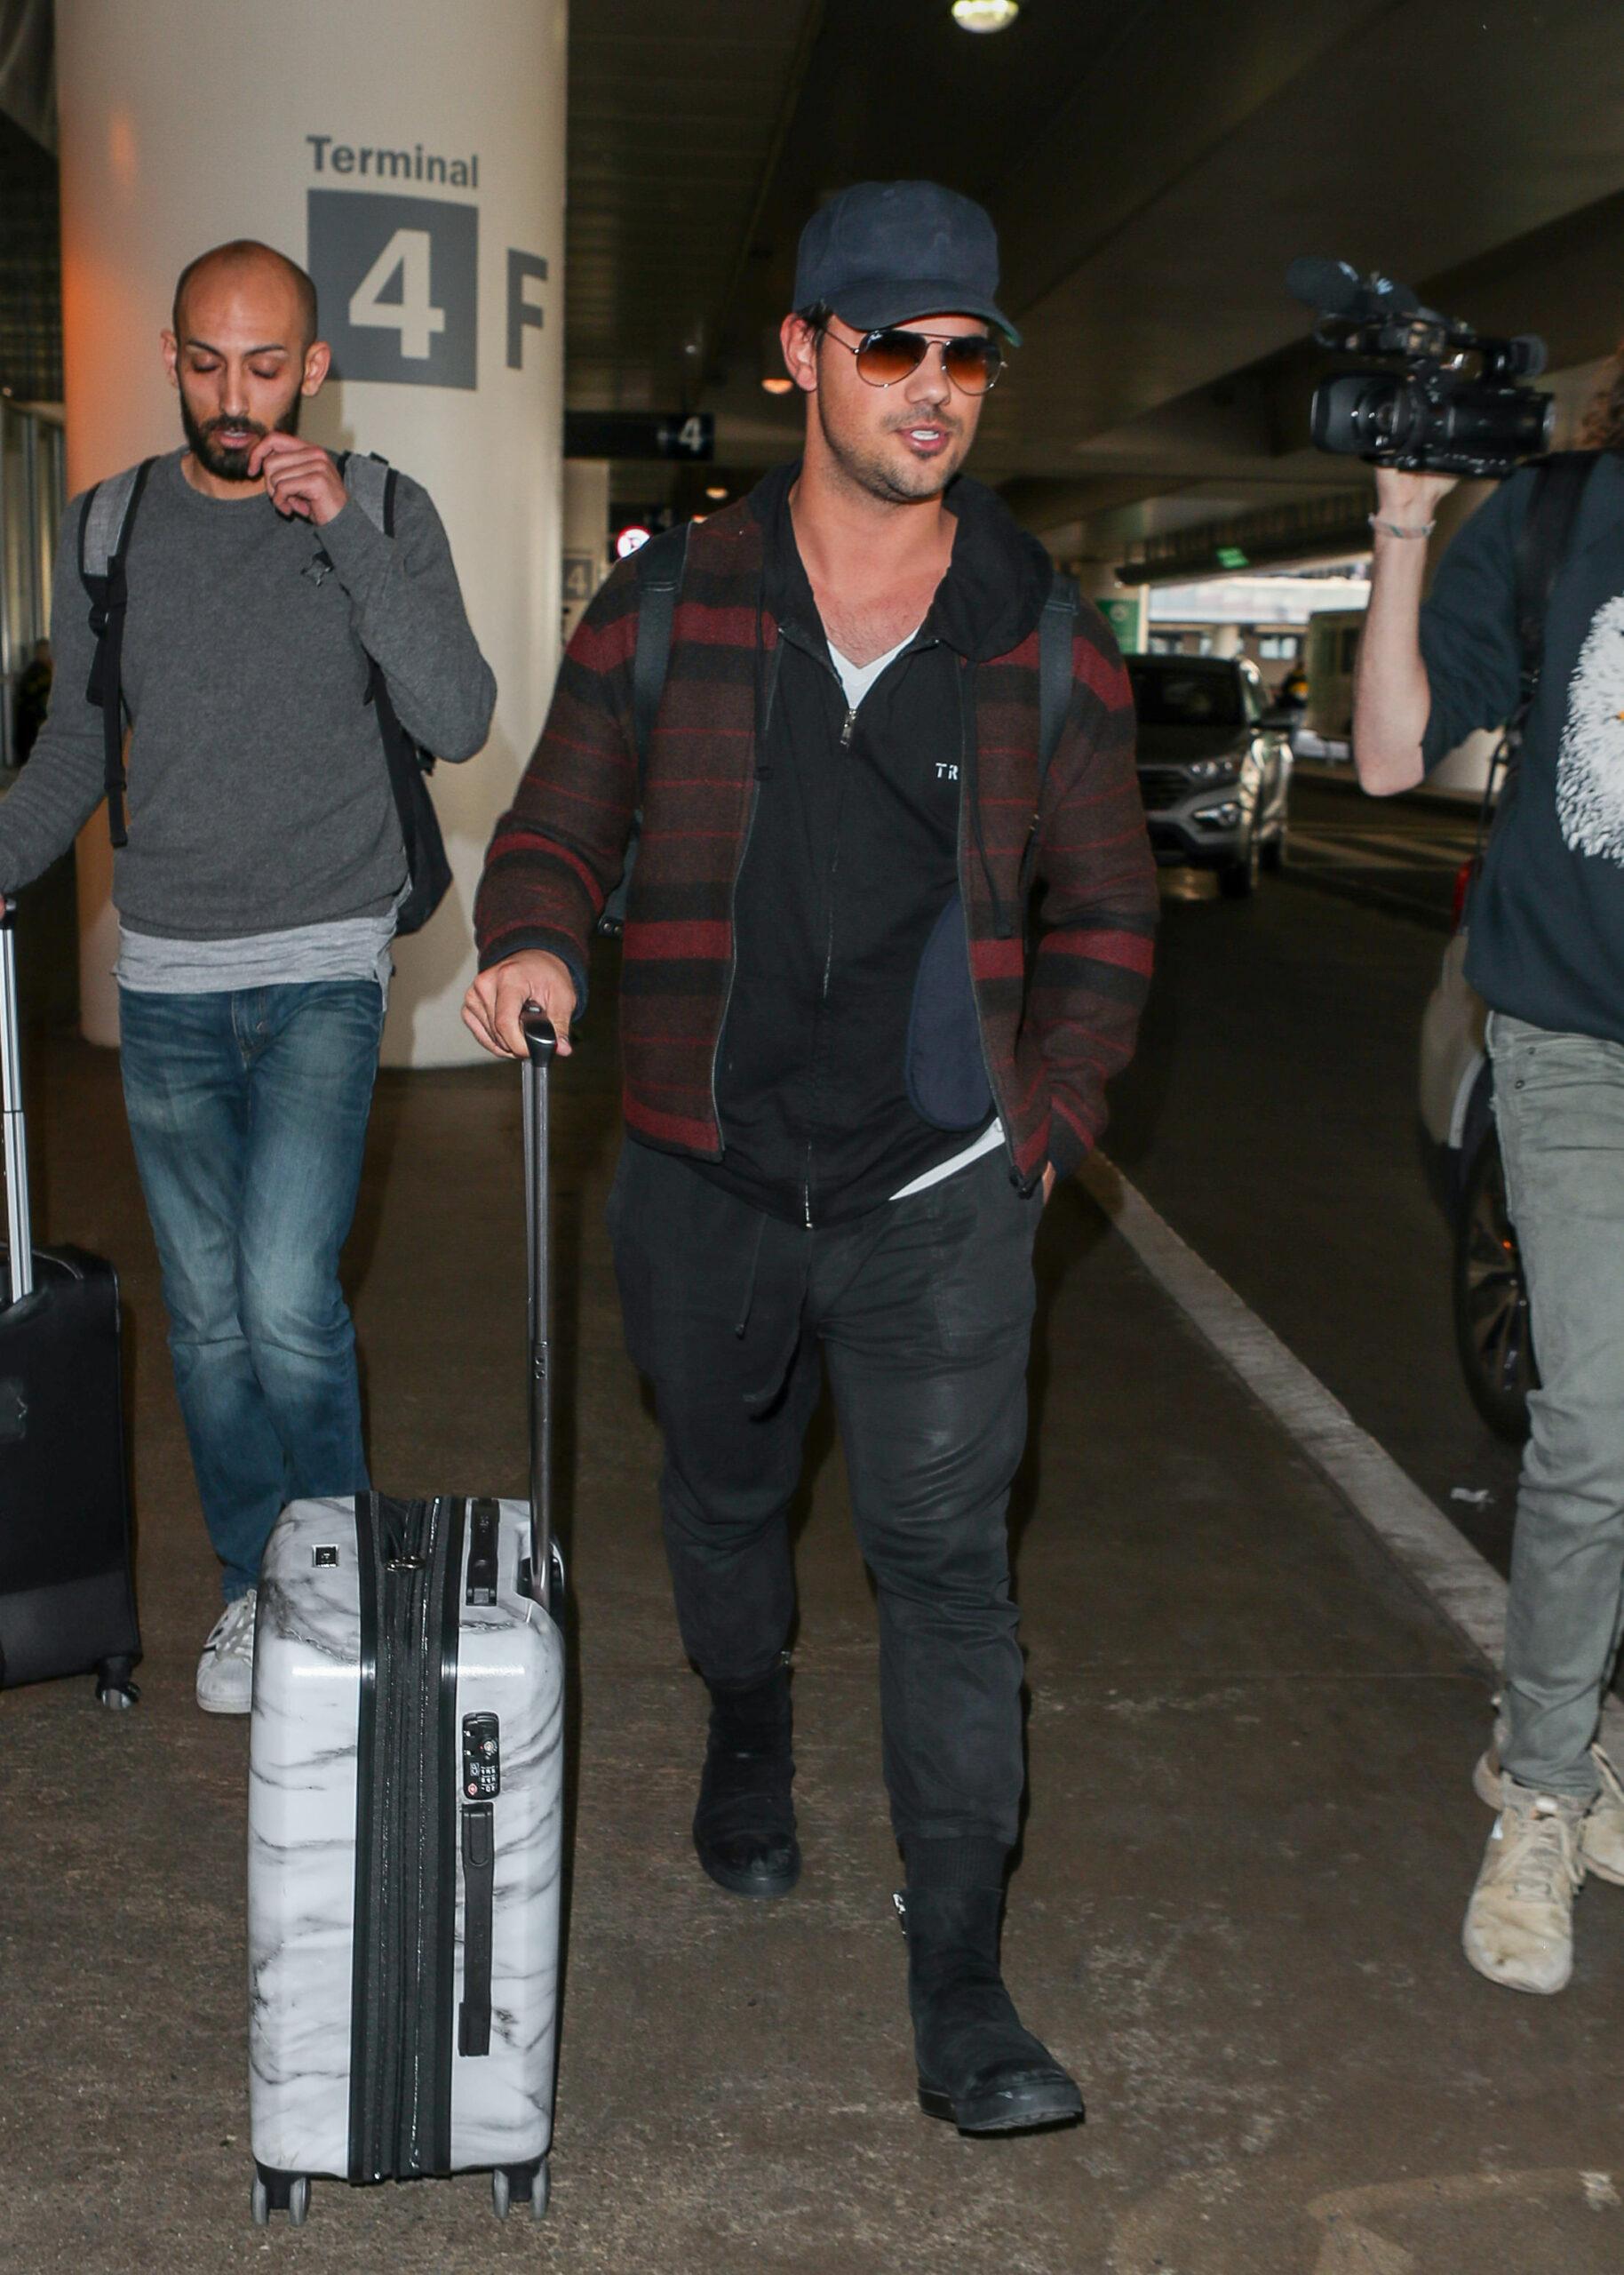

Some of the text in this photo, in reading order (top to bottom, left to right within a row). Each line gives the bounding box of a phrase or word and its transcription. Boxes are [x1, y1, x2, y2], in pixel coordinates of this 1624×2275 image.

[306, 135, 478, 188] Terminal
[348, 228, 445, 360] 4
[506, 246, 548, 371] F
[679, 417, 702, 451] 4
[935, 762, 959, 781] TR
